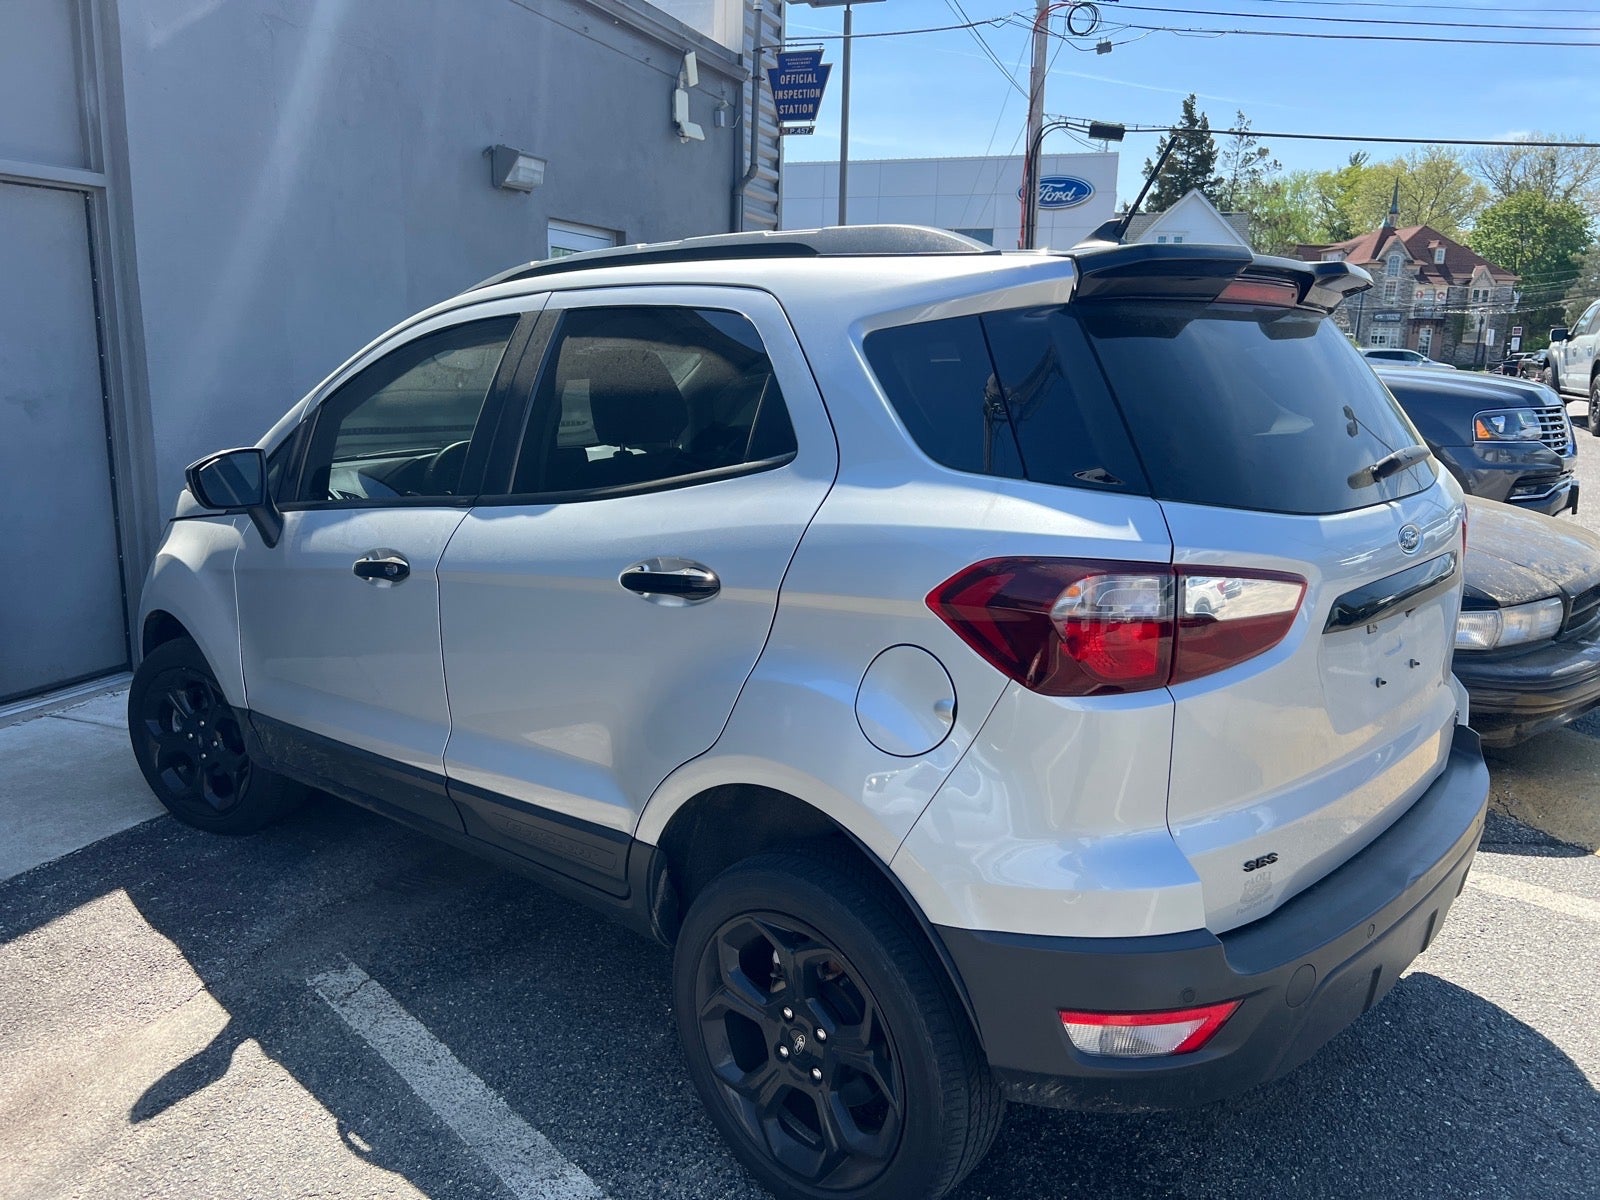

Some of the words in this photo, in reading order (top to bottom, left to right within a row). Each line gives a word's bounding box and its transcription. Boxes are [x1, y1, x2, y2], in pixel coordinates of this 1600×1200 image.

[780, 73, 818, 85] OFFICIAL
[774, 88, 820, 100] INSPECTION
[779, 104, 813, 114] STATION
[1039, 183, 1076, 201] Ford
[1242, 852, 1278, 872] SES
